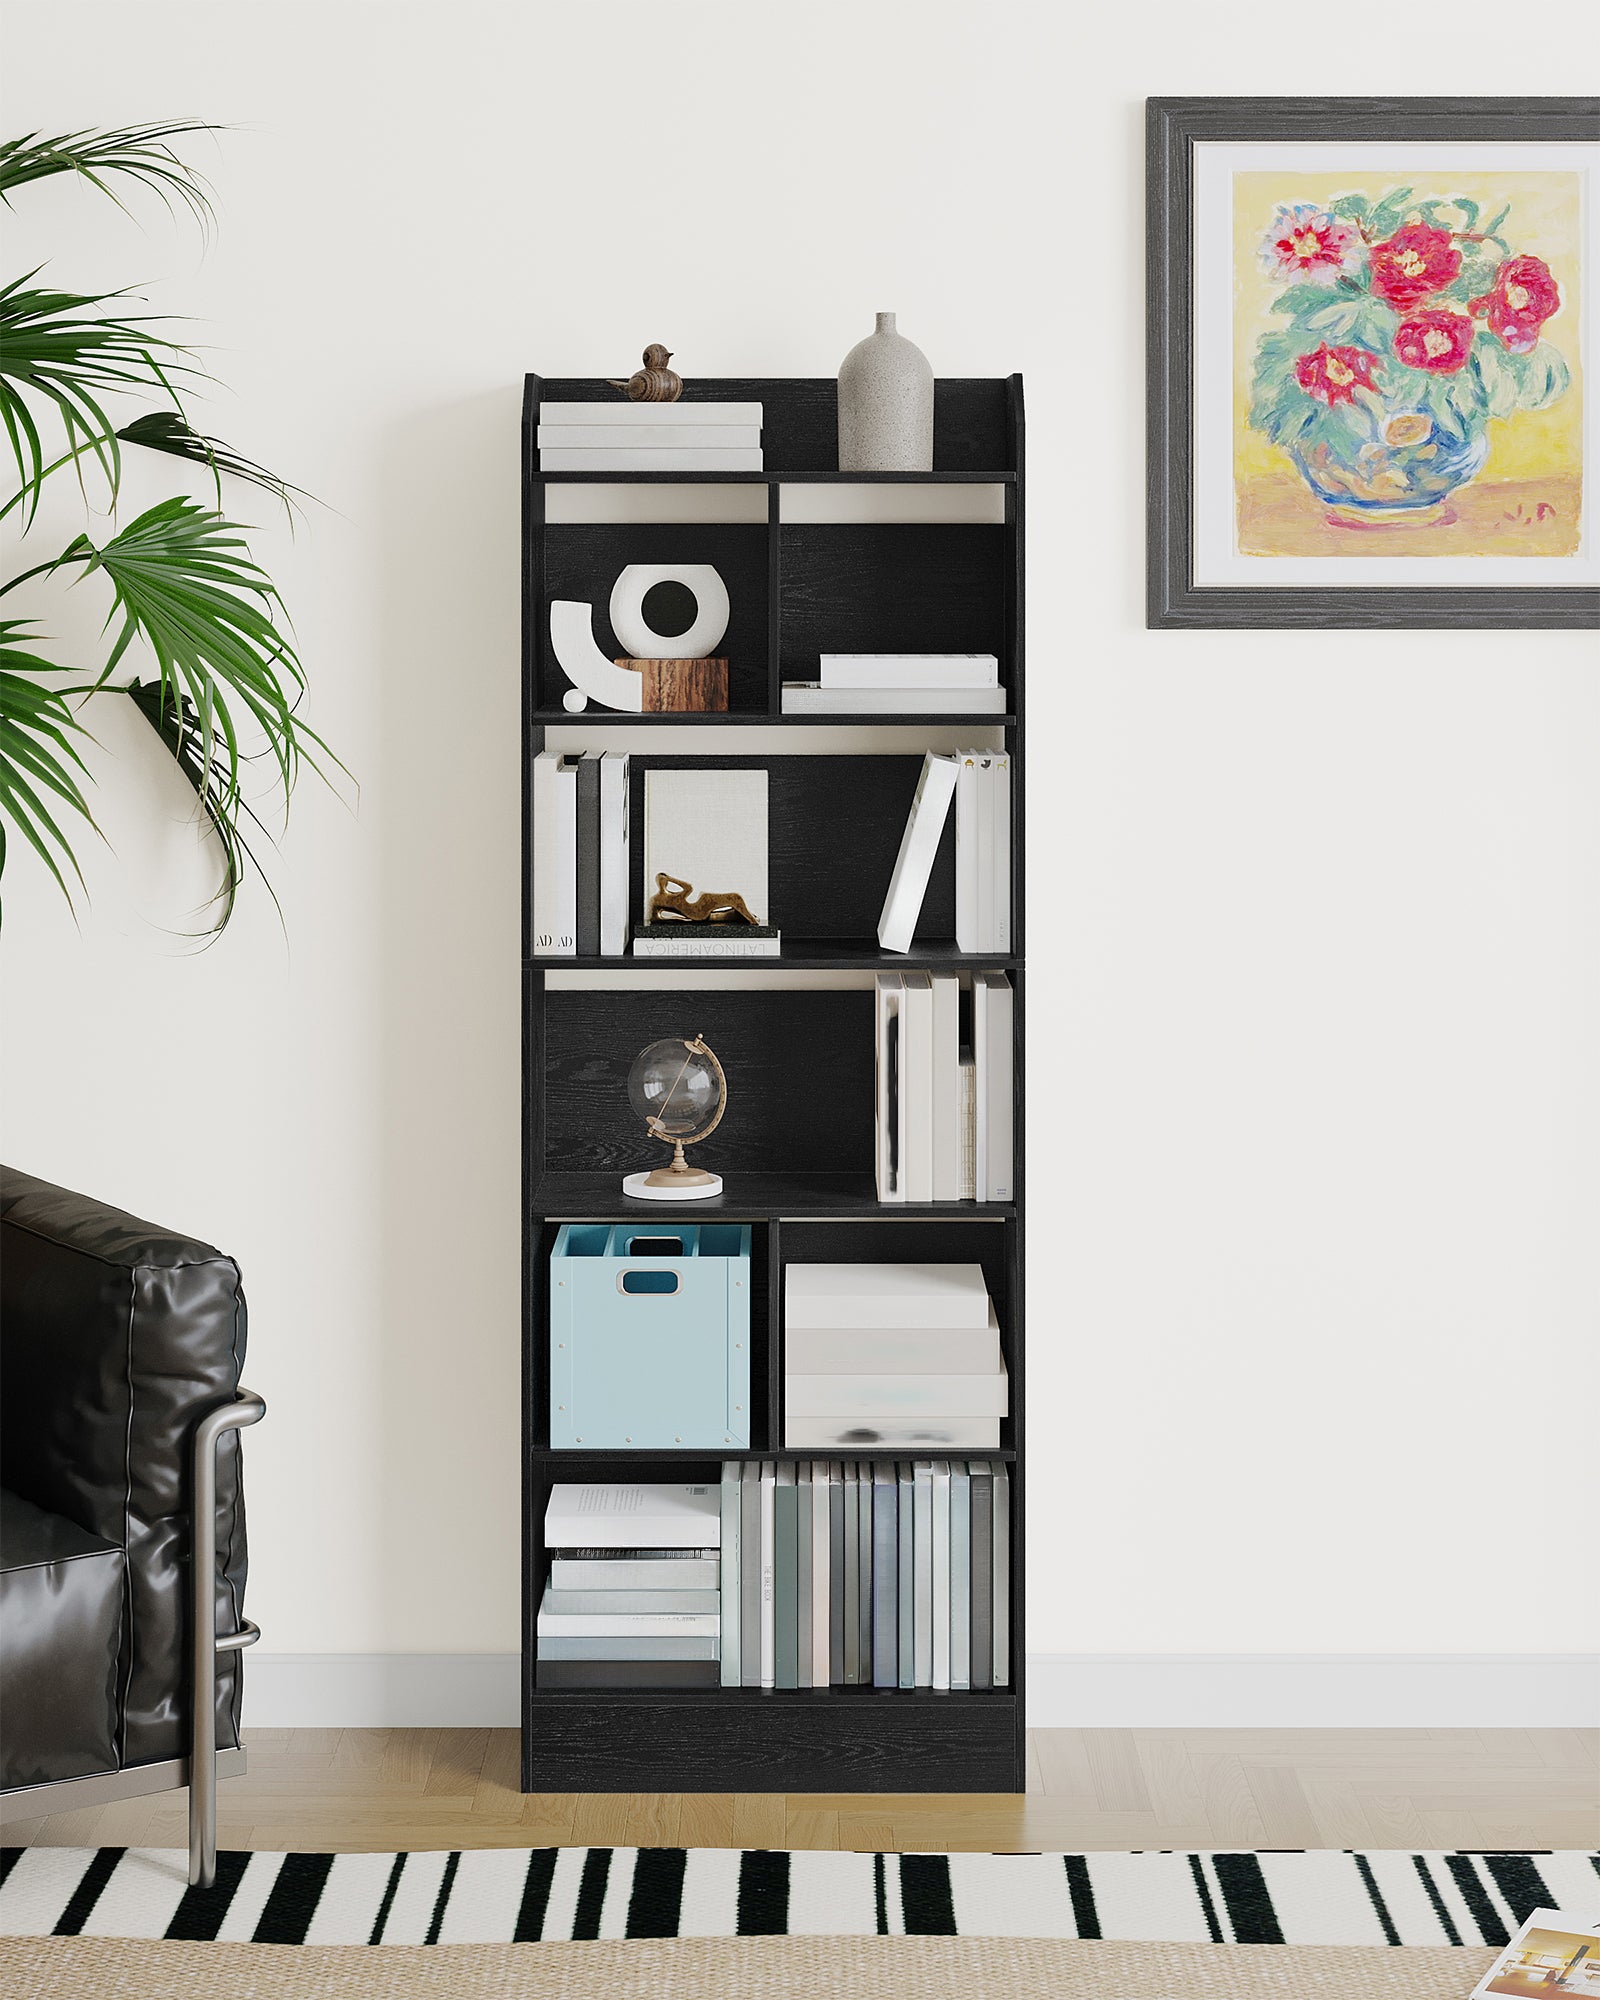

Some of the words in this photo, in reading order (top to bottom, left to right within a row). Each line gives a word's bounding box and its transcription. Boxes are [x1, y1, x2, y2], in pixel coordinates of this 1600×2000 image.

[536, 934, 552, 947] AD
[557, 936, 573, 947] AD
[645, 943, 766, 955] LATINOAMERICA
